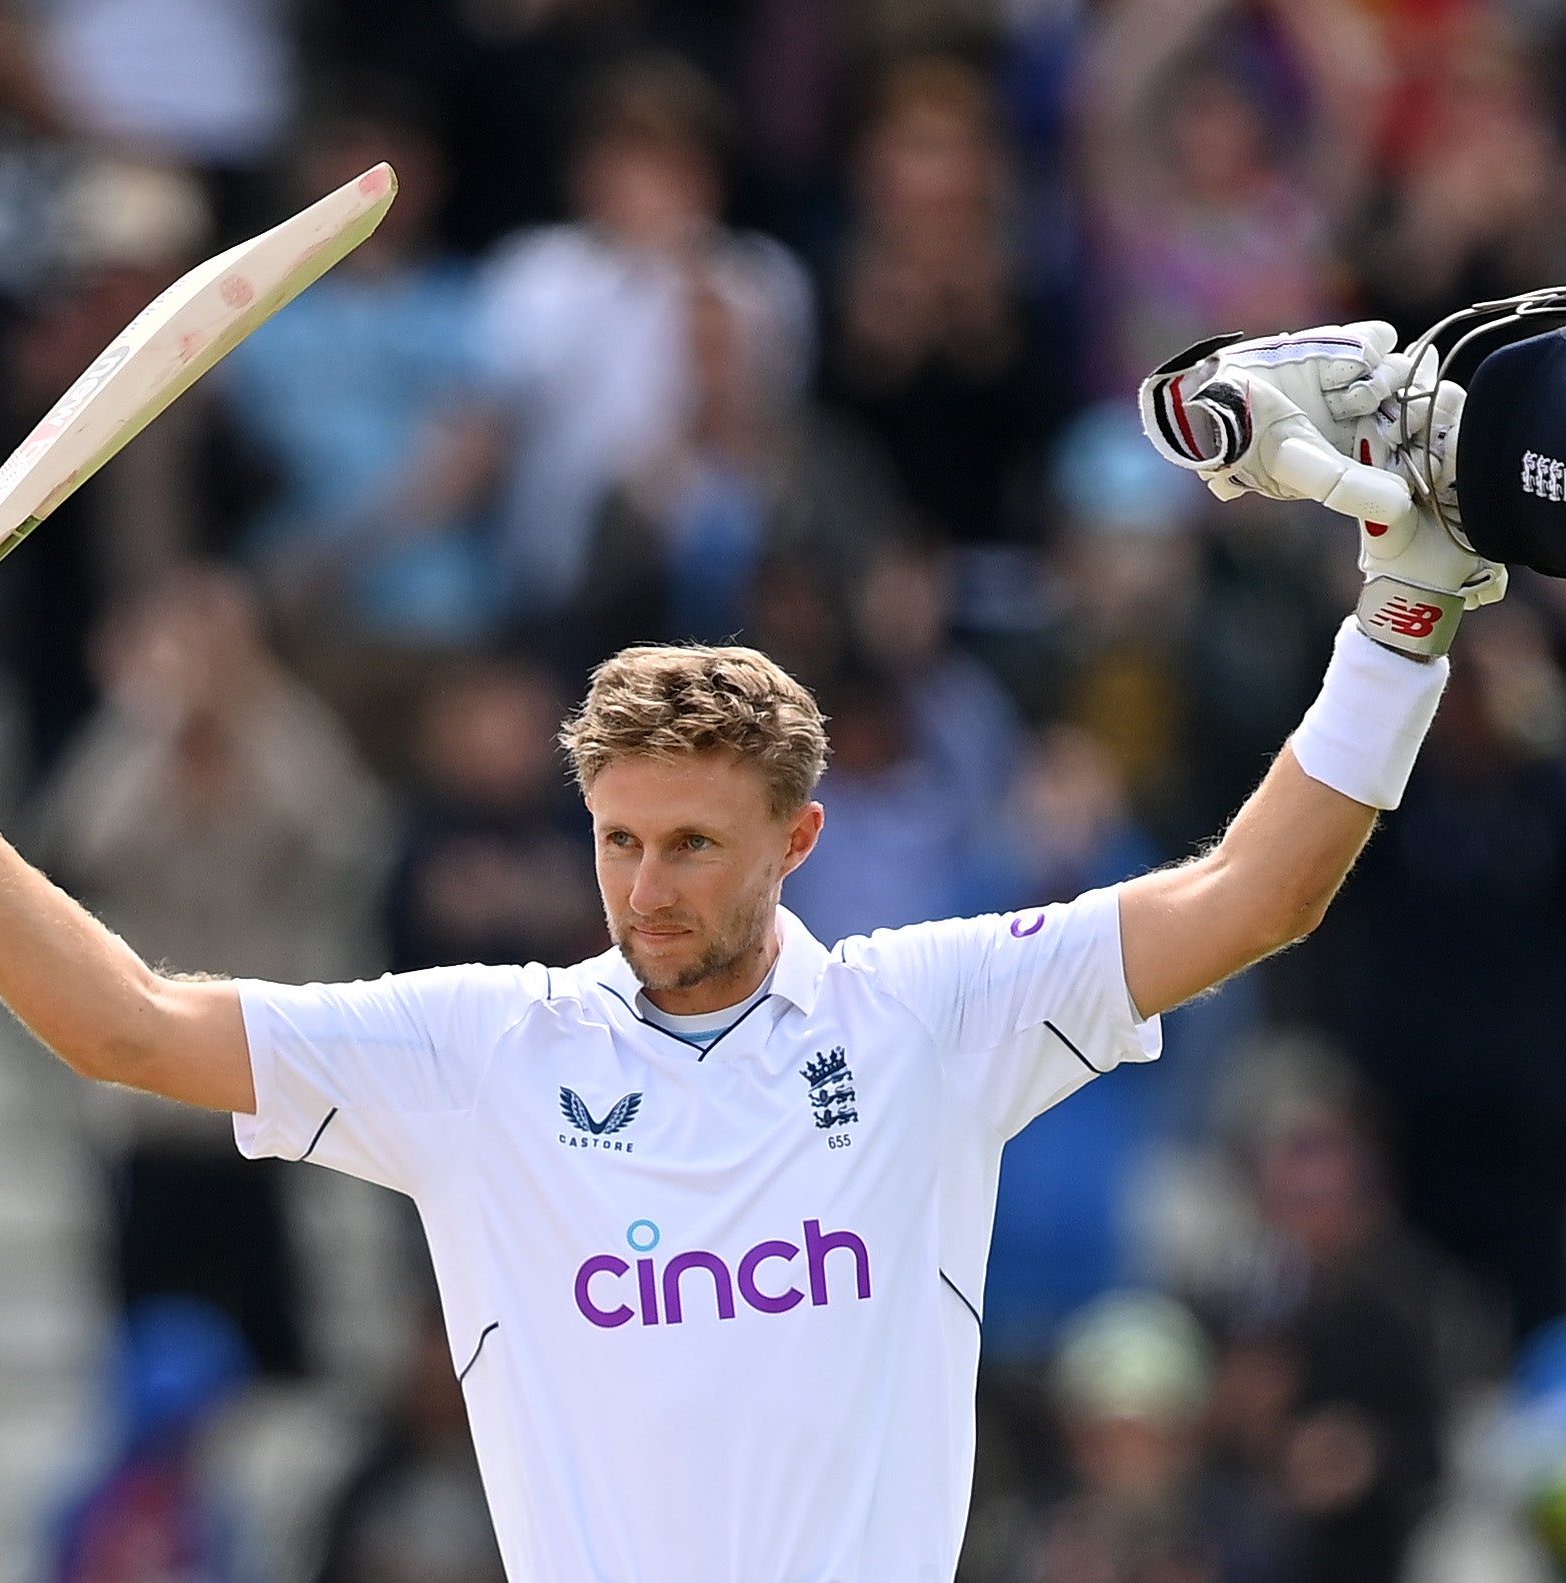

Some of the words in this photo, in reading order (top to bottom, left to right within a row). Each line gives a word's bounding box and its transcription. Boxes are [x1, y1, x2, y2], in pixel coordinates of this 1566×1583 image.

[559, 1134, 634, 1153] CASTORE
[828, 1134, 851, 1149] 655
[574, 1219, 871, 1328] cinch
